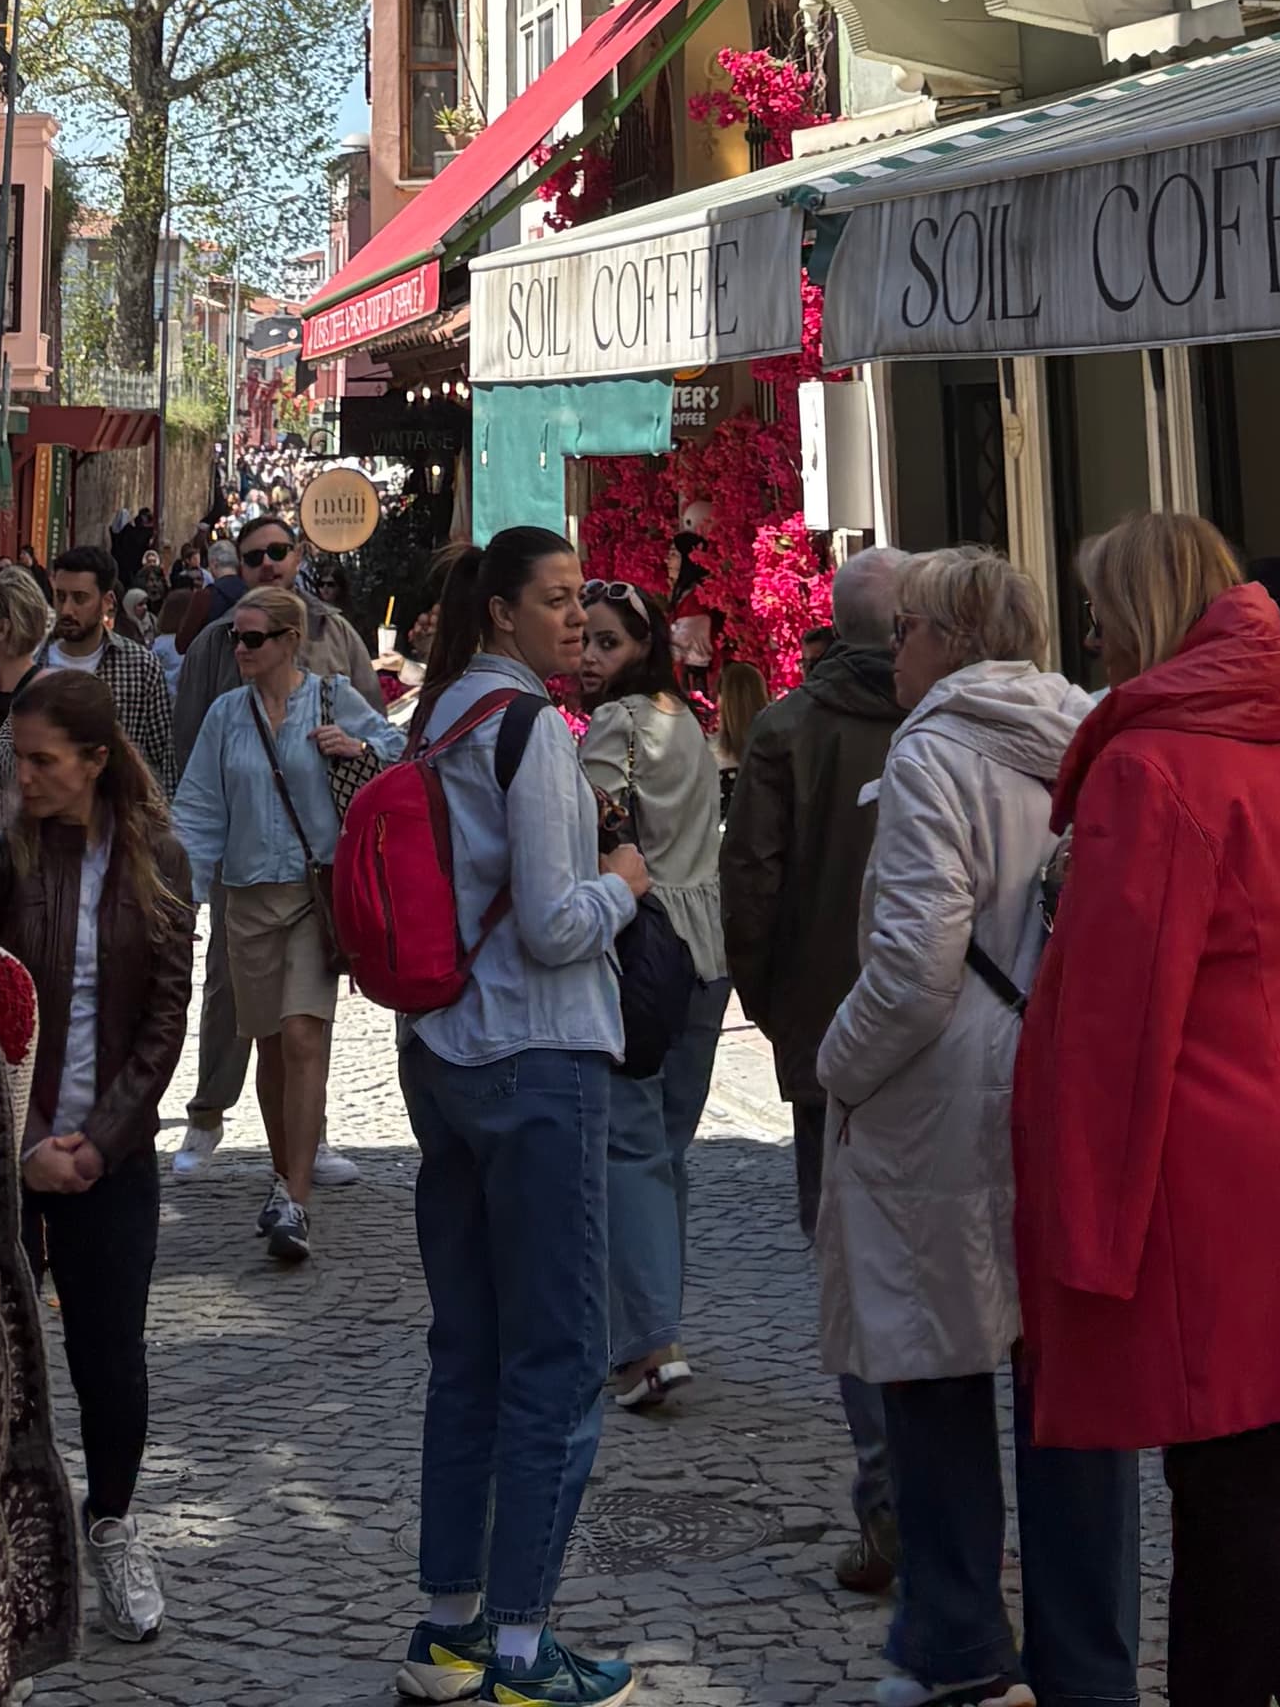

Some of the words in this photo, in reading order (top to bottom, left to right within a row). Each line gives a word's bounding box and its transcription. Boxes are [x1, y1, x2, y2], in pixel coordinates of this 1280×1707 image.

[901, 203, 1041, 329] SOIL
[506, 275, 571, 360] SOIL
[591, 239, 740, 351] COFFEE
[673, 385, 720, 410] TER'S
[672, 412, 707, 426] OFFEE
[370, 429, 455, 451] VINTAGE
